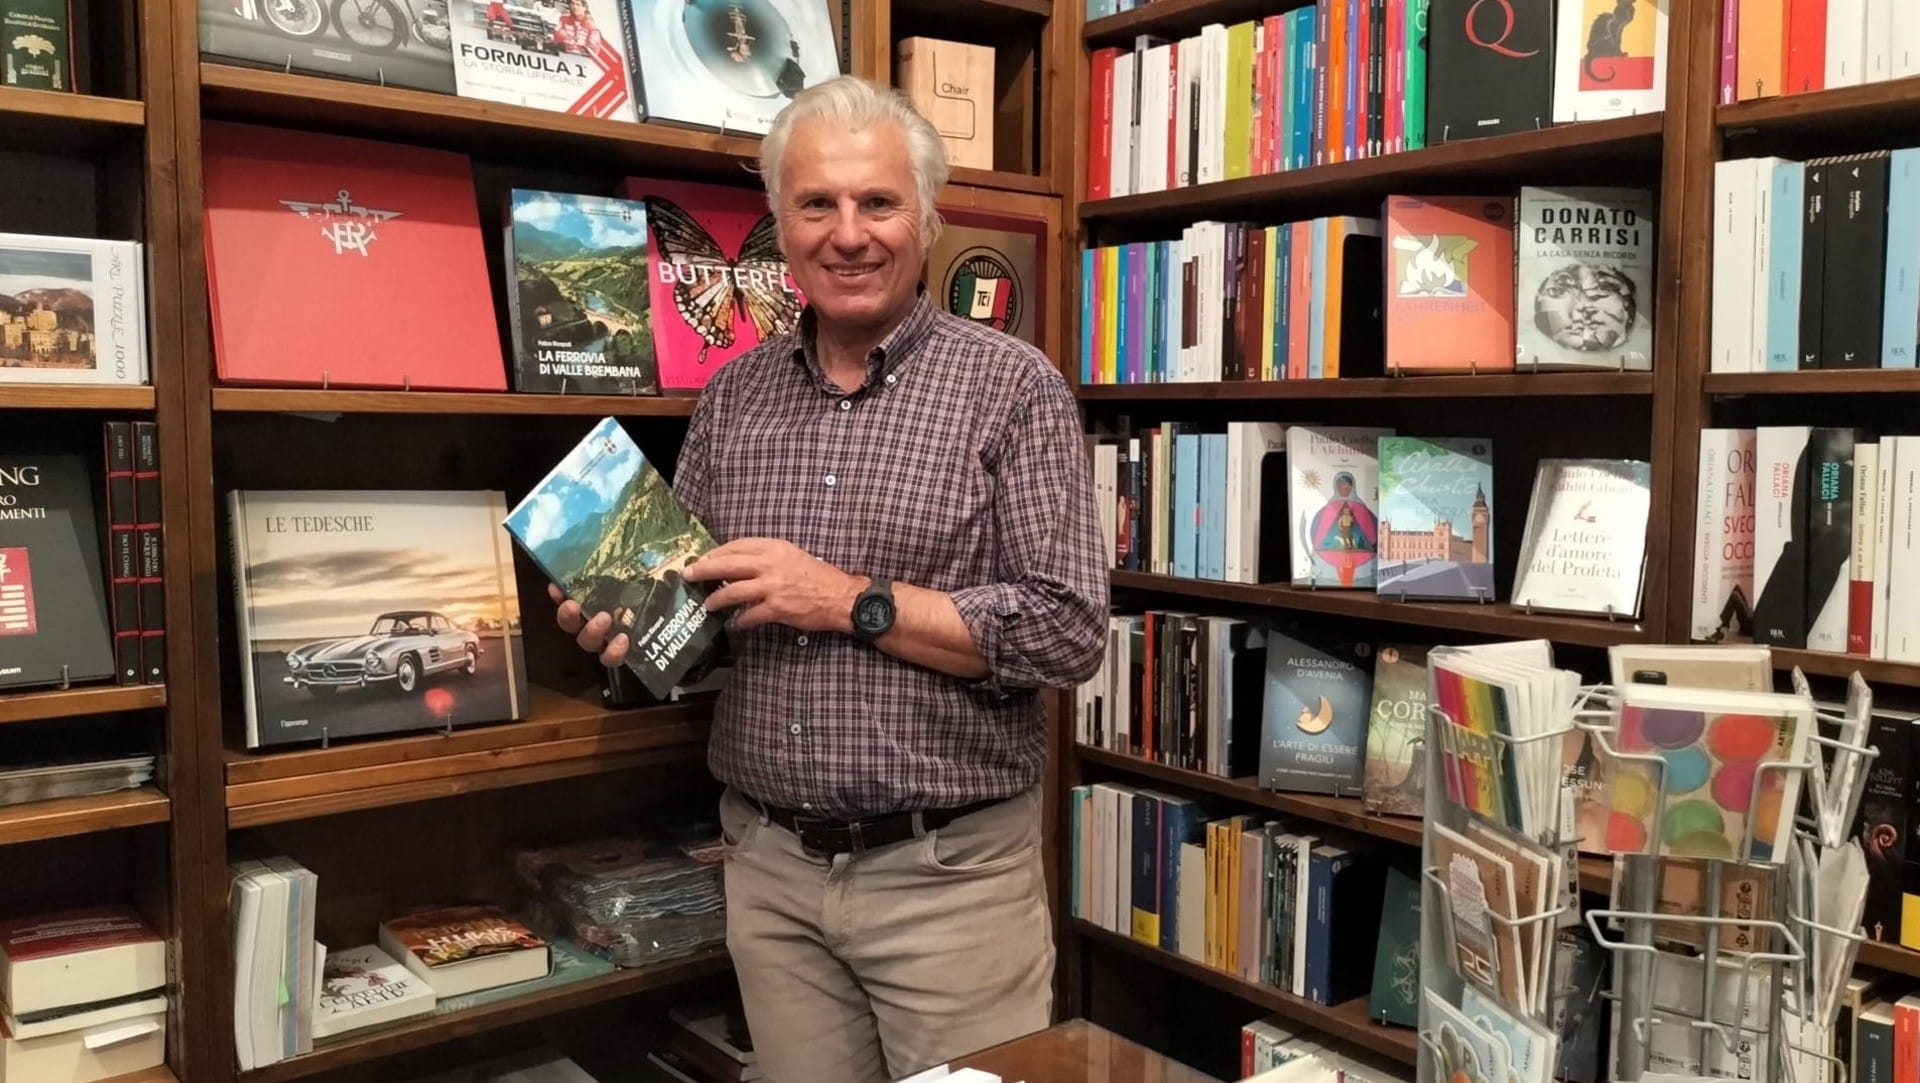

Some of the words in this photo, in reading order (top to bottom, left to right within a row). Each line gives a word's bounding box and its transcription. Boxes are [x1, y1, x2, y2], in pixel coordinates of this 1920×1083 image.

[1465, 0, 1540, 58] Q
[460, 43, 570, 75] FORMULA
[575, 64, 587, 79] 1
[463, 59, 478, 69] LA
[481, 62, 523, 77] STORIA
[527, 71, 584, 87] UFFICIALE
[941, 82, 970, 96] Chair
[1542, 207, 1636, 226] DONATO
[1534, 227, 1640, 246] CARRISI
[1537, 250, 1548, 258] LA
[1549, 250, 1571, 258] CASA
[1573, 250, 1601, 259] SENZA
[1602, 251, 1637, 260] RICORDI
[658, 262, 802, 294] BUTTERFL
[115, 344, 126, 380] 1000
[538, 350, 553, 362] LA
[555, 352, 606, 364] FERROVIA
[539, 363, 550, 375] DI
[553, 364, 583, 376] VALLE
[585, 365, 642, 378] BREMBANA
[1772, 462, 1781, 499] FALLACI
[1781, 462, 1790, 498] ORIANA
[1821, 462, 1831, 500] FALLACI
[1830, 462, 1839, 499] ORIANA
[1859, 465, 1867, 490] Oriana
[1858, 491, 1867, 516] Fallaci
[266, 516, 287, 533] LE
[291, 515, 375, 533] TEDESCHE
[1553, 528, 1611, 545] Lettere
[1546, 544, 1611, 561] d'amore
[1531, 560, 1555, 574] del
[1562, 561, 1621, 579] Profeta
[645, 641, 663, 660] LA
[657, 598, 699, 646] FERROVIA
[655, 655, 670, 671] DI
[663, 626, 692, 659] VALLE
[1287, 658, 1355, 671] ALESSANDRO
[1297, 669, 1344, 681] D'AVENIA
[1272, 740, 1306, 749] L'ARTE
[1307, 742, 1318, 750] DI
[1319, 743, 1358, 756] ESSERE
[1295, 753, 1335, 765] FRAGILI
